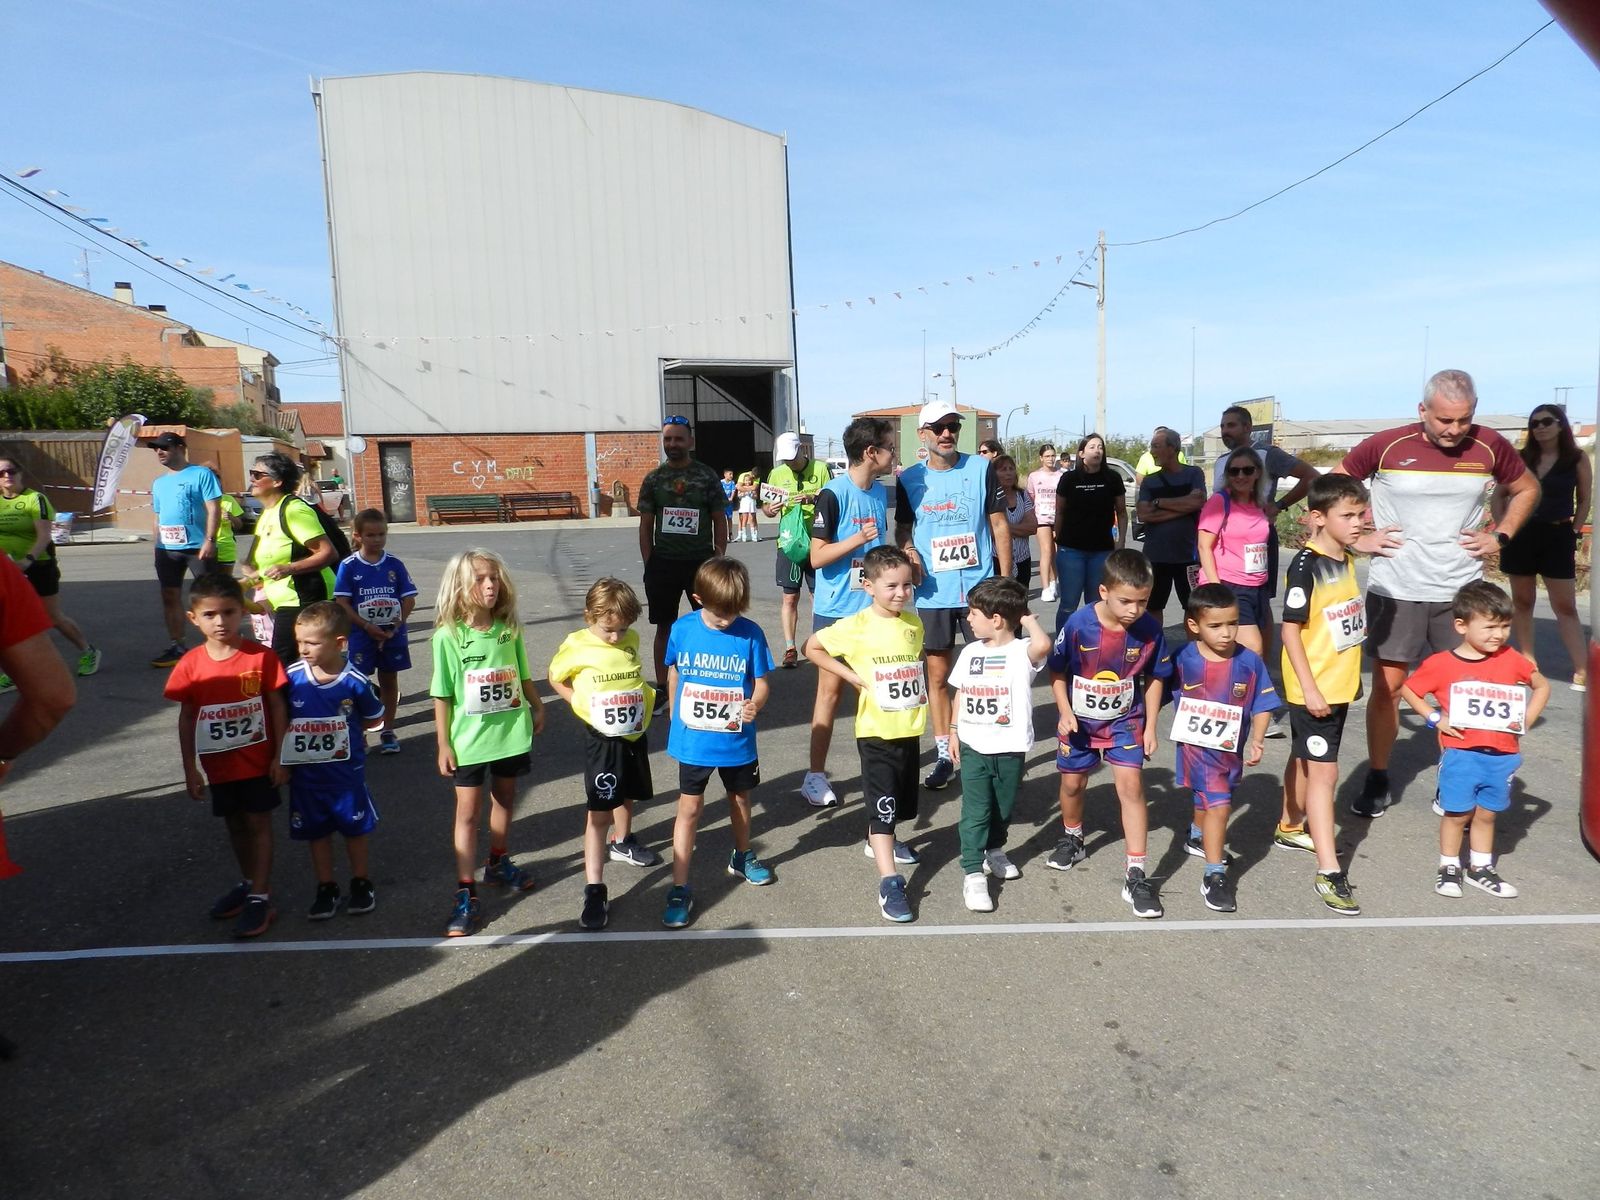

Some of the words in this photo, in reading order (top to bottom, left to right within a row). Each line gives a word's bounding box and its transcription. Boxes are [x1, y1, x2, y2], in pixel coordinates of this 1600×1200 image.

[453, 461, 464, 474] C
[471, 460, 481, 472] Y
[668, 516, 693, 528] 432
[940, 545, 970, 562] 440
[360, 587, 395, 595] Emirates
[368, 607, 393, 618] 547
[1326, 600, 1364, 621] beduni
[1341, 613, 1364, 636] 546
[677, 652, 690, 667] LA
[694, 652, 747, 673] ARMUÑA
[682, 668, 698, 676] CLUB
[699, 670, 741, 681] DEPORTIVO
[480, 683, 513, 702] 555
[683, 686, 743, 702] bedunia
[888, 679, 920, 699] 560
[1074, 679, 1133, 695] bedunia
[1453, 685, 1524, 702] bedunia
[693, 701, 730, 720] 554
[966, 697, 998, 715] 565
[1085, 693, 1122, 710] 566
[1467, 698, 1511, 719] 563
[200, 702, 262, 720] bedunia
[604, 705, 637, 725] 559
[1180, 701, 1241, 721] bedunia
[209, 718, 252, 740] 552
[288, 720, 346, 734] bedunia
[1187, 715, 1228, 738] 567
[294, 734, 336, 753] 548
